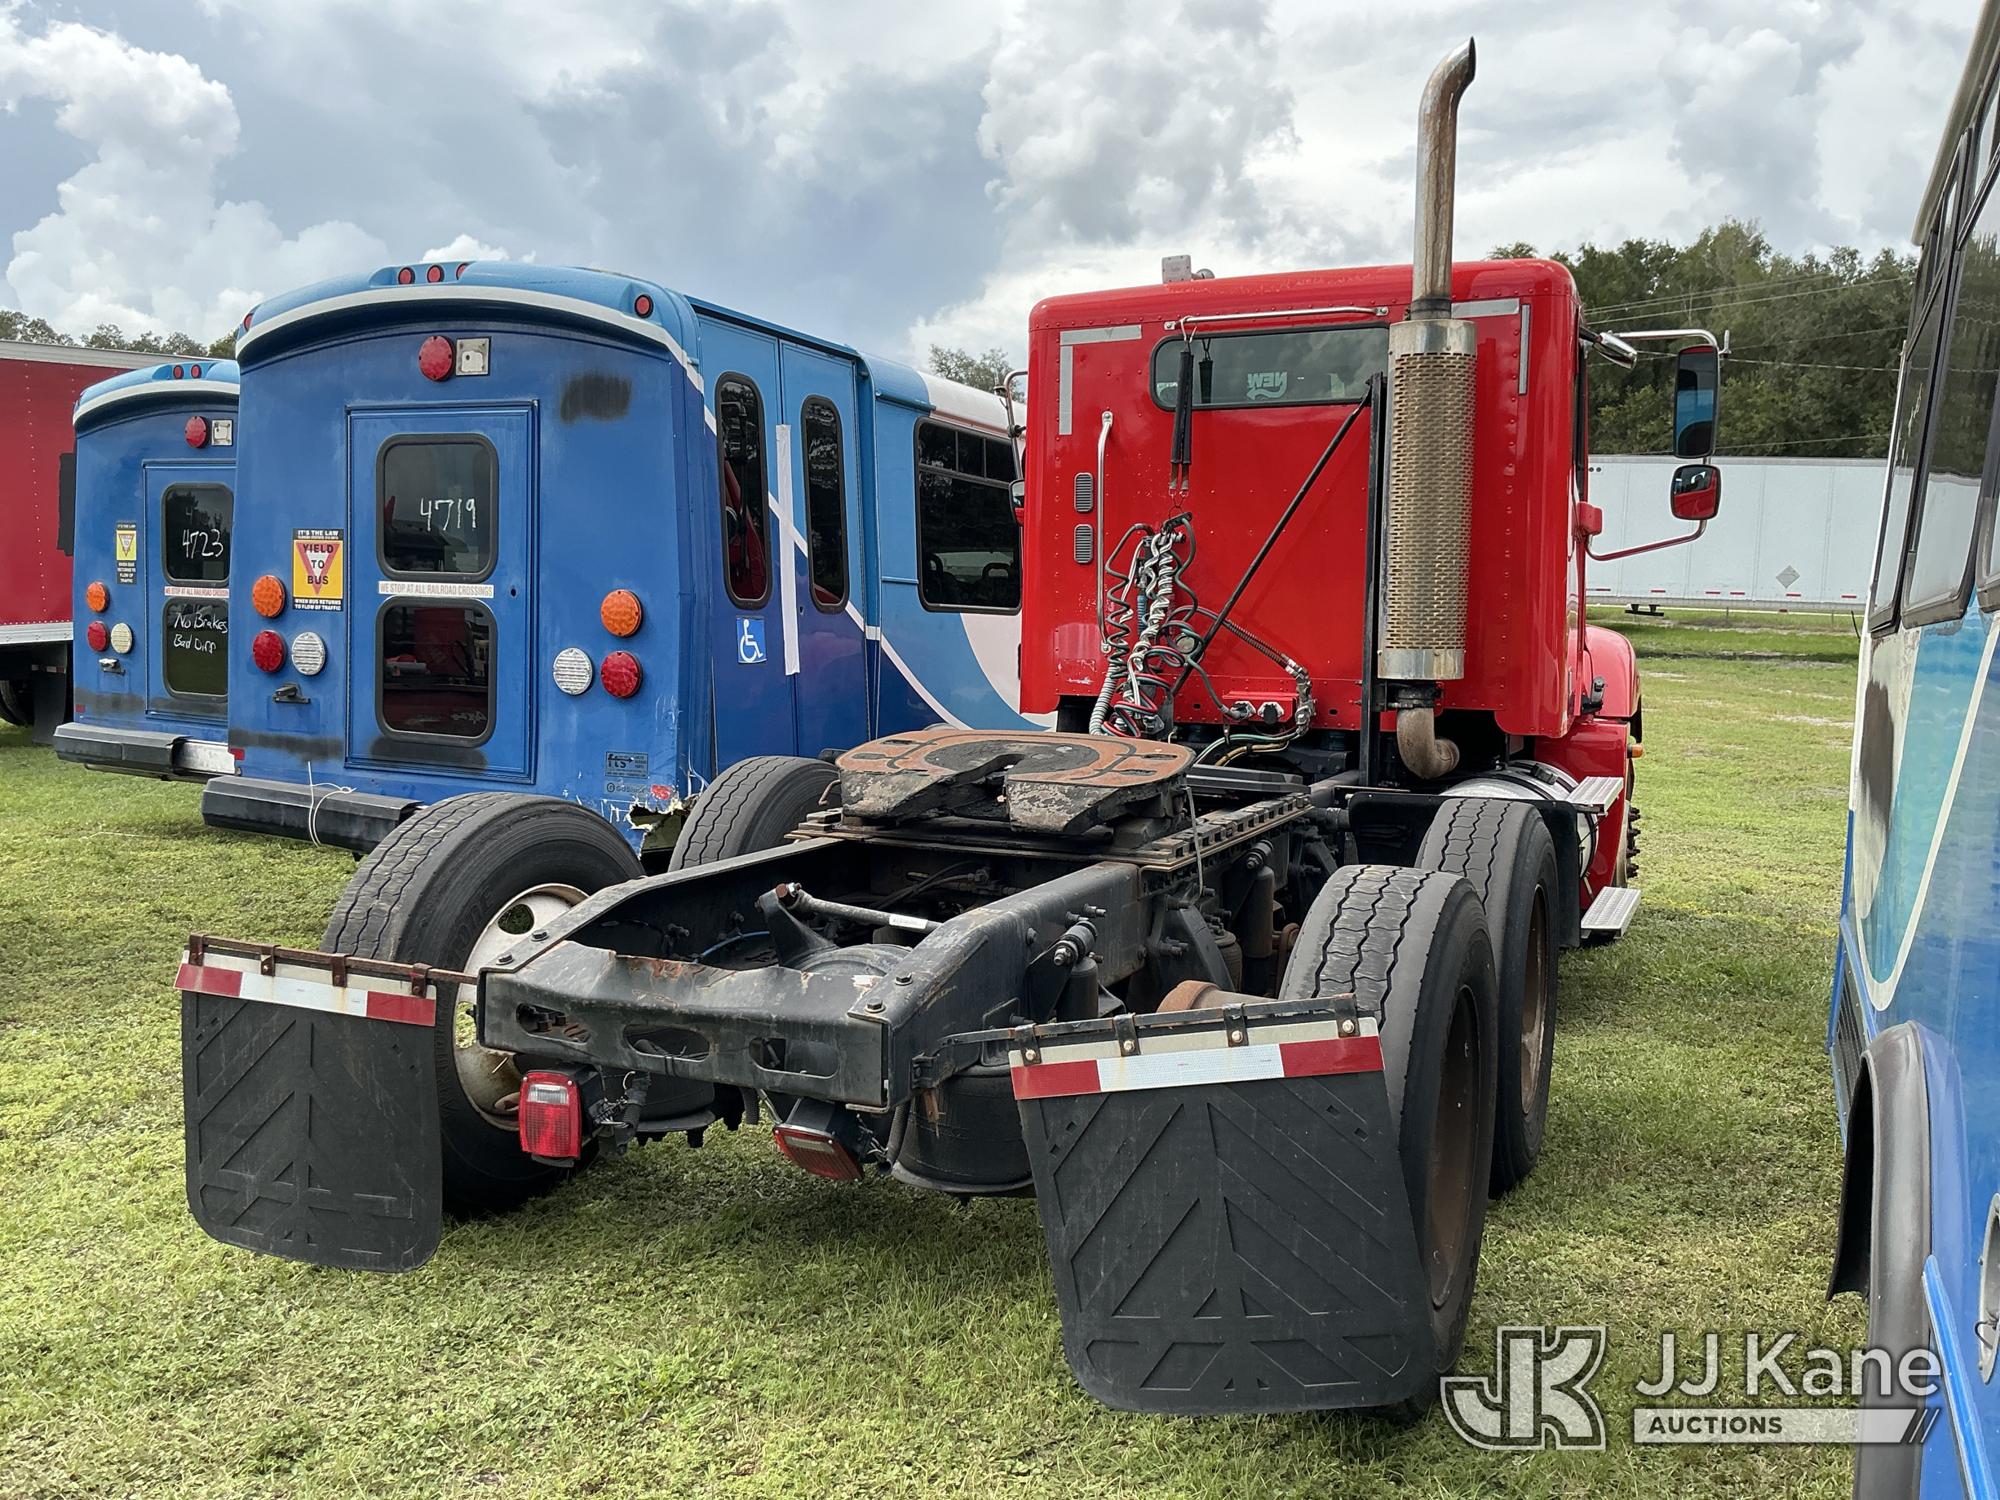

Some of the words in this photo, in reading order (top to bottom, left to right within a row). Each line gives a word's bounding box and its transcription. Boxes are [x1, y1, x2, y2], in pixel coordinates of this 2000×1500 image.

[420, 498, 476, 531] 4719
[182, 528, 224, 559] 4723
[303, 544, 334, 554] YIELD
[311, 560, 324, 569] TO
[308, 576, 328, 584] BUS
[380, 584, 388, 592] WE
[390, 584, 405, 593] STOP
[406, 584, 414, 593] AT
[414, 584, 426, 594] ALL
[427, 585, 457, 595] RAILROAD
[458, 585, 492, 596] CROSSINGS
[174, 612, 192, 628] No
[194, 612, 228, 634] Brakes
[174, 634, 192, 649] Bad
